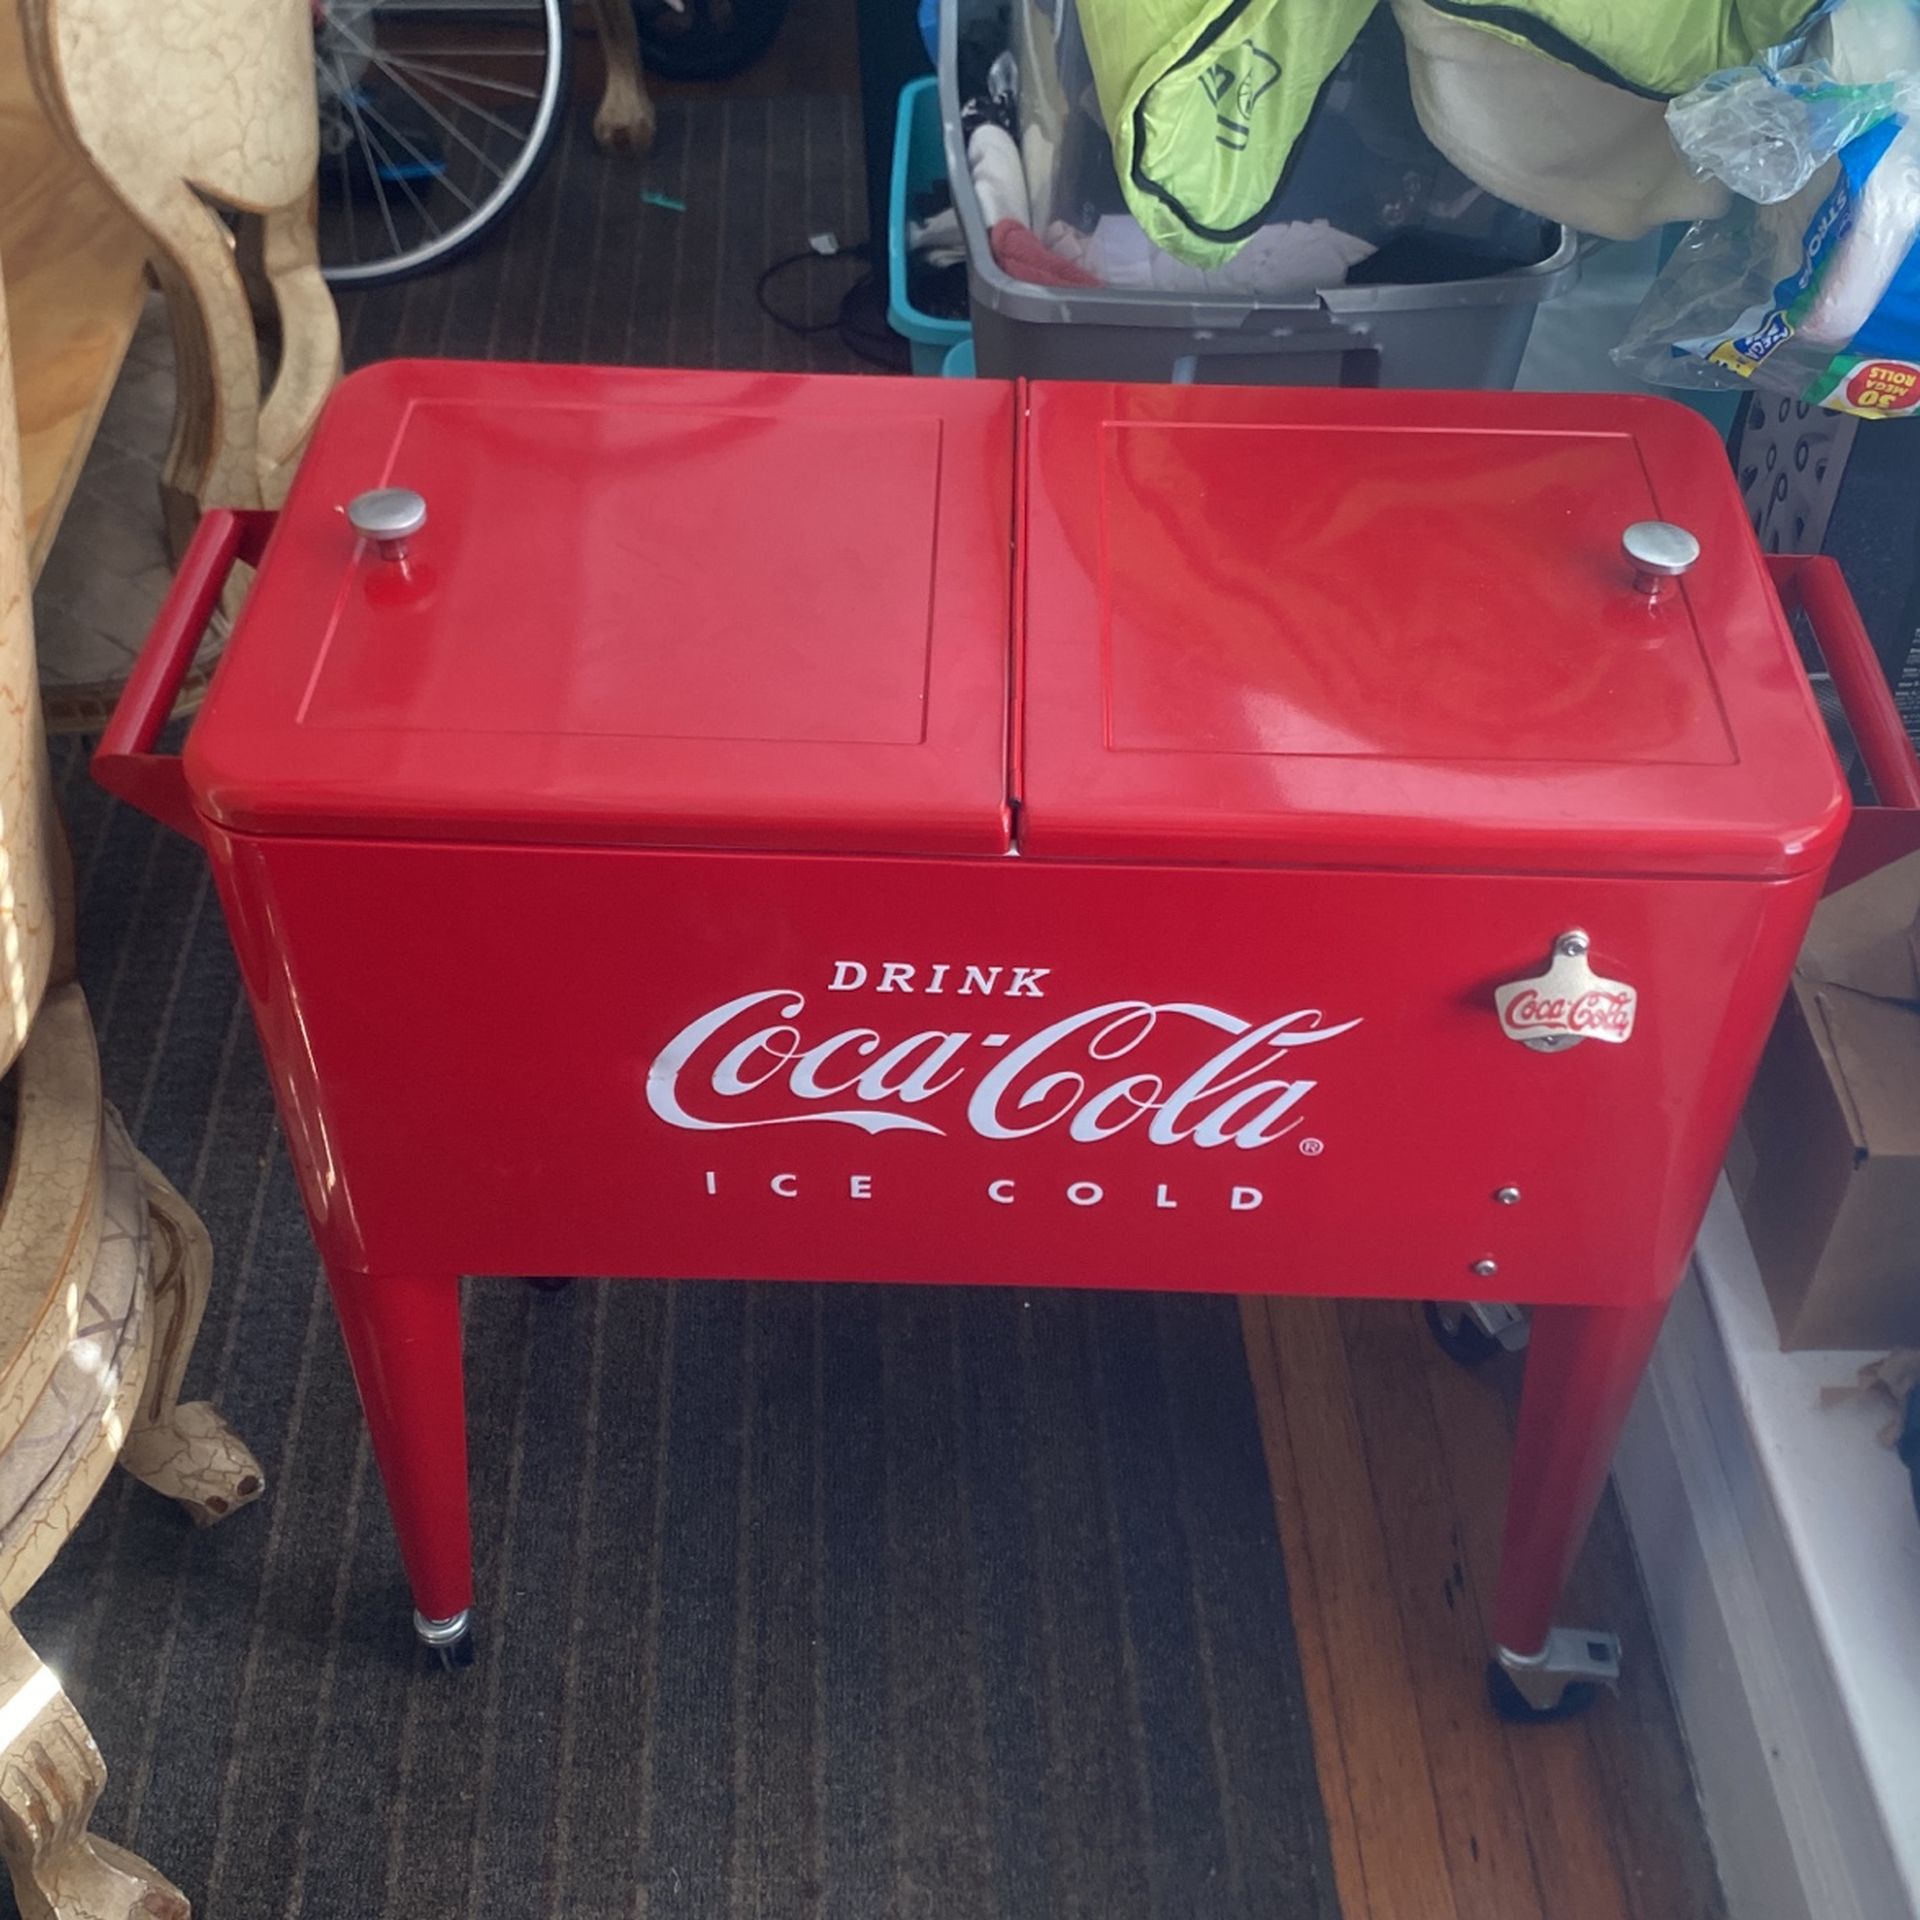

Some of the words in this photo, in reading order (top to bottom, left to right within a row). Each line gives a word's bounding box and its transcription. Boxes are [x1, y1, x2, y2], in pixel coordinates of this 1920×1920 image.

[1866, 379, 1909, 396] MEGA
[1868, 367, 1916, 387] ROLLS
[828, 961, 1051, 998] DRINK
[645, 989, 1364, 1151] Coca-Cola
[706, 1171, 872, 1199] ICE
[988, 1179, 1264, 1211] COLD
